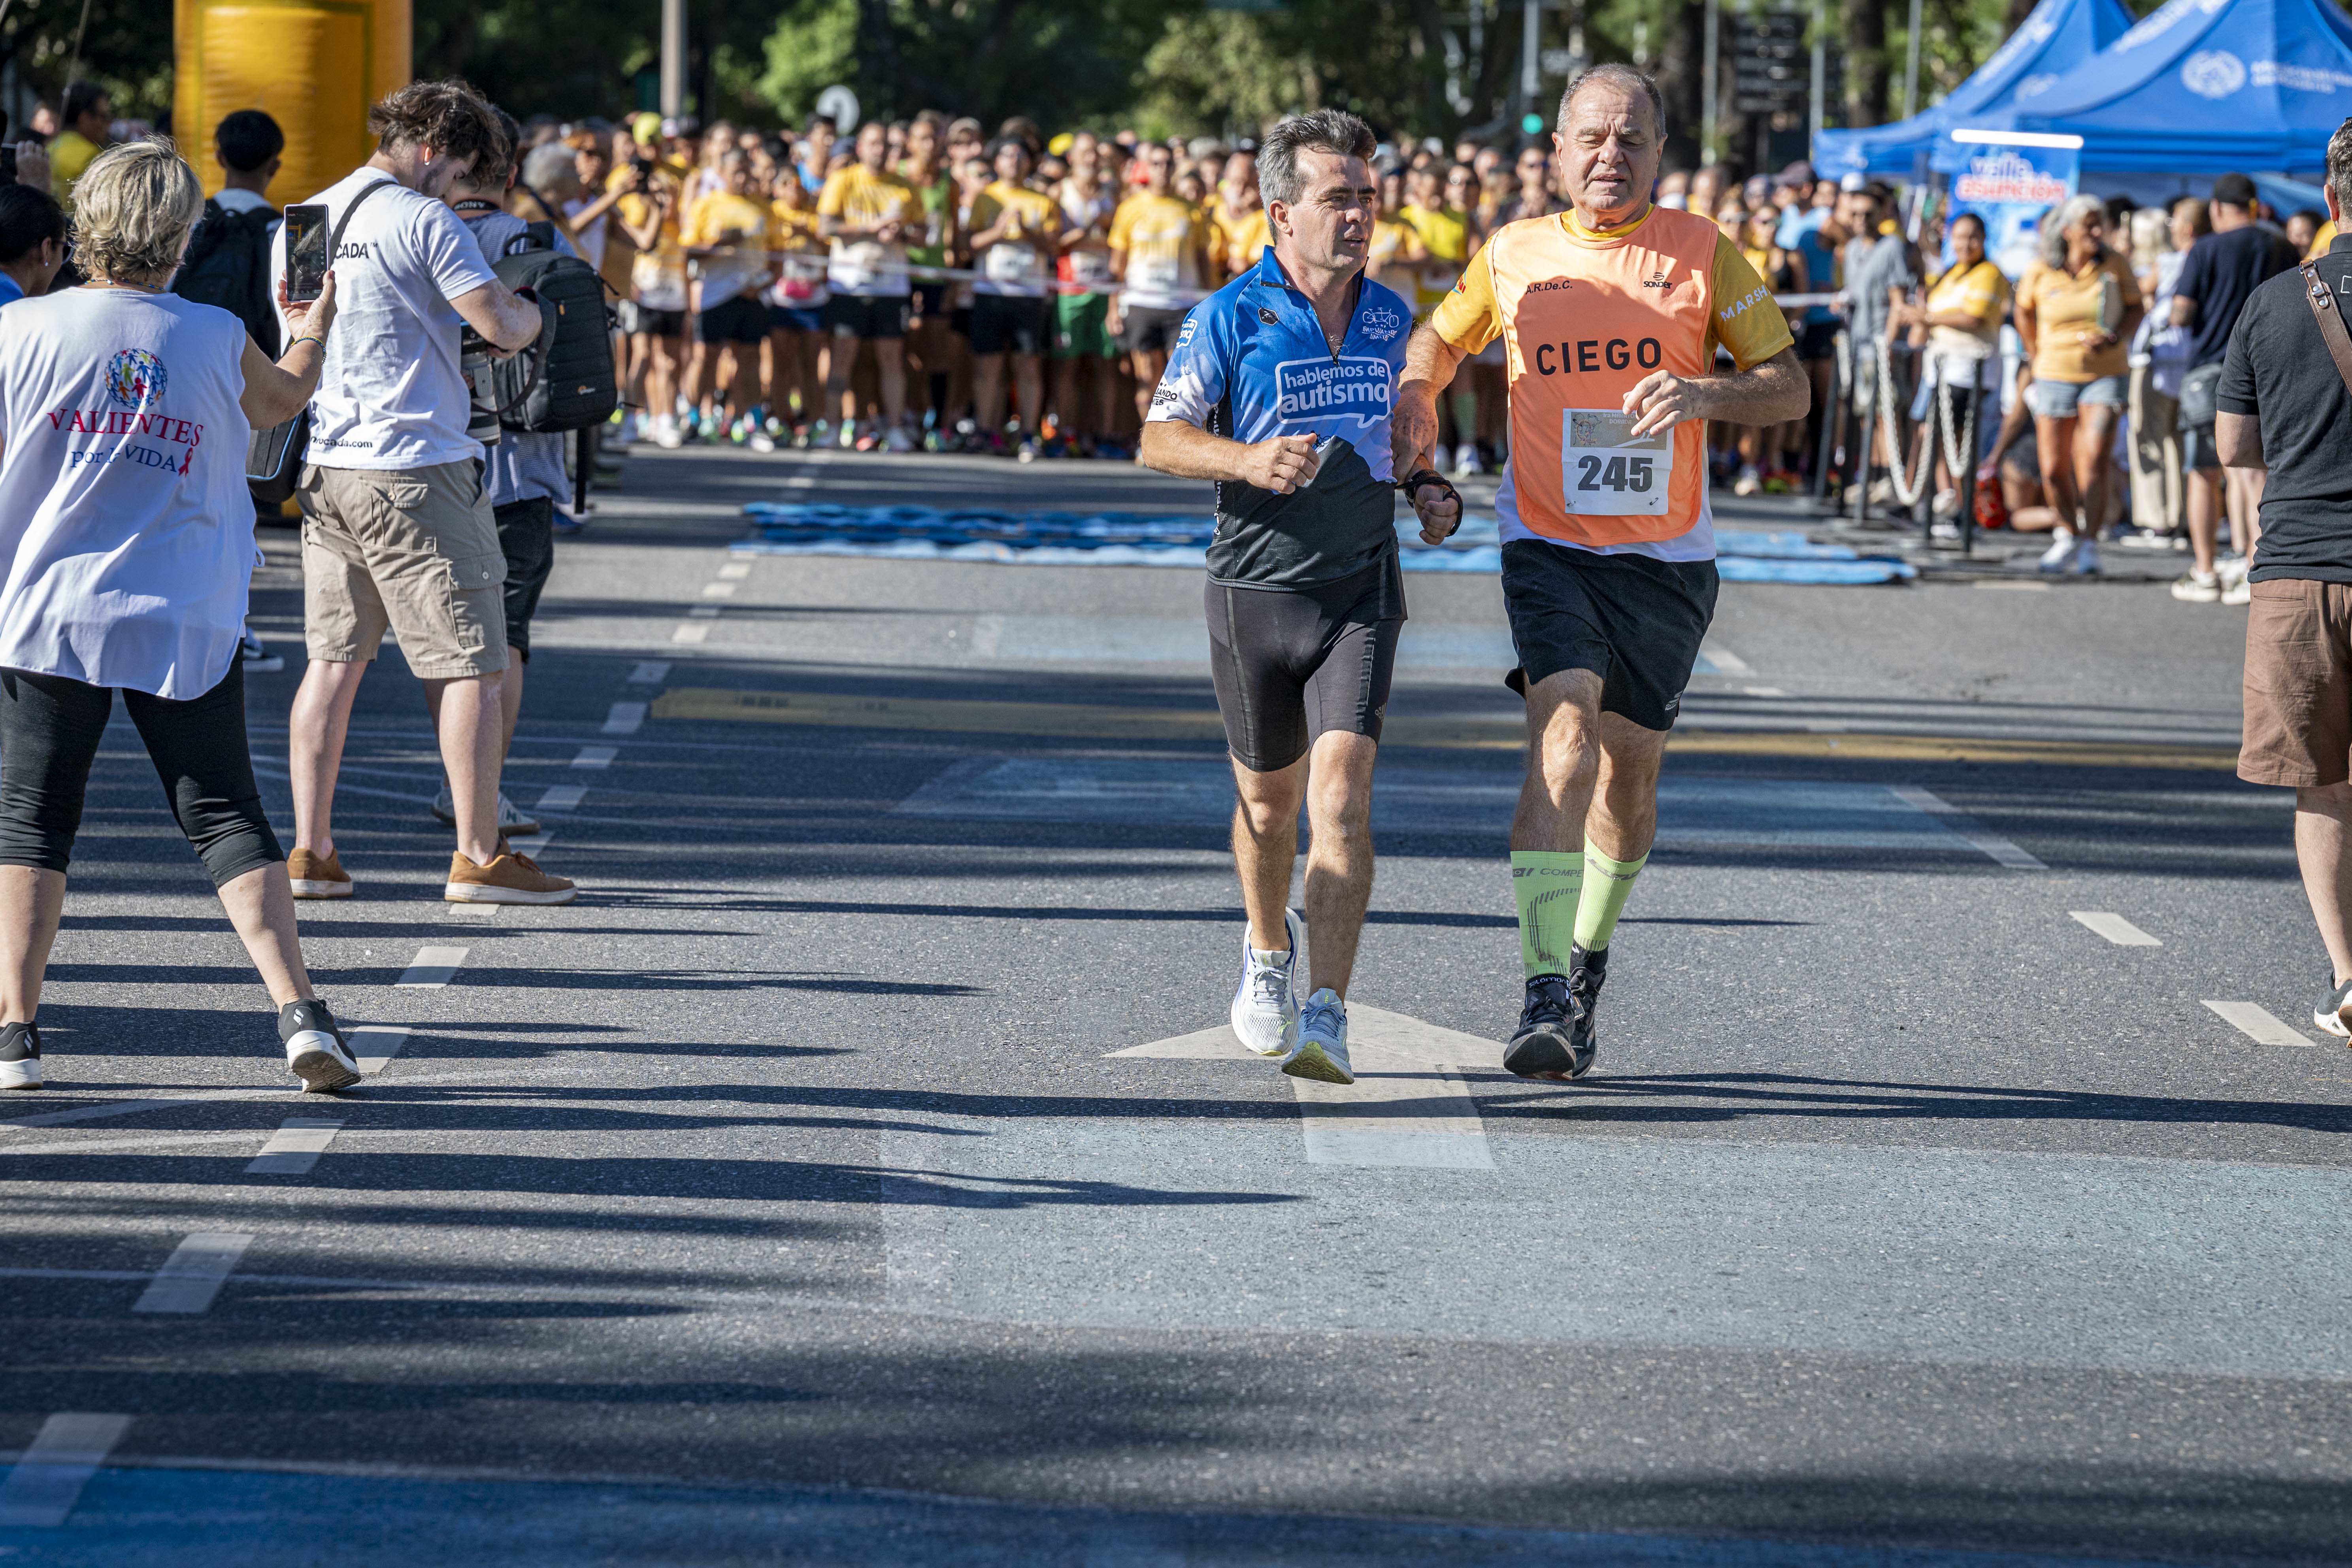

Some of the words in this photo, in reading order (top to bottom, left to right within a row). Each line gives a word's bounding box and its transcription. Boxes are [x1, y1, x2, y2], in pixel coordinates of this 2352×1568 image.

[1720, 285, 1771, 322] MARSH
[1536, 337, 1662, 375] CIEGO
[1284, 366, 1364, 389] hablemos
[1367, 361, 1385, 377] de
[1281, 379, 1389, 413] autismo
[47, 409, 204, 447] VALIENTES
[70, 451, 103, 468] por
[124, 443, 177, 472] VIDA
[1577, 455, 1653, 492] 245
